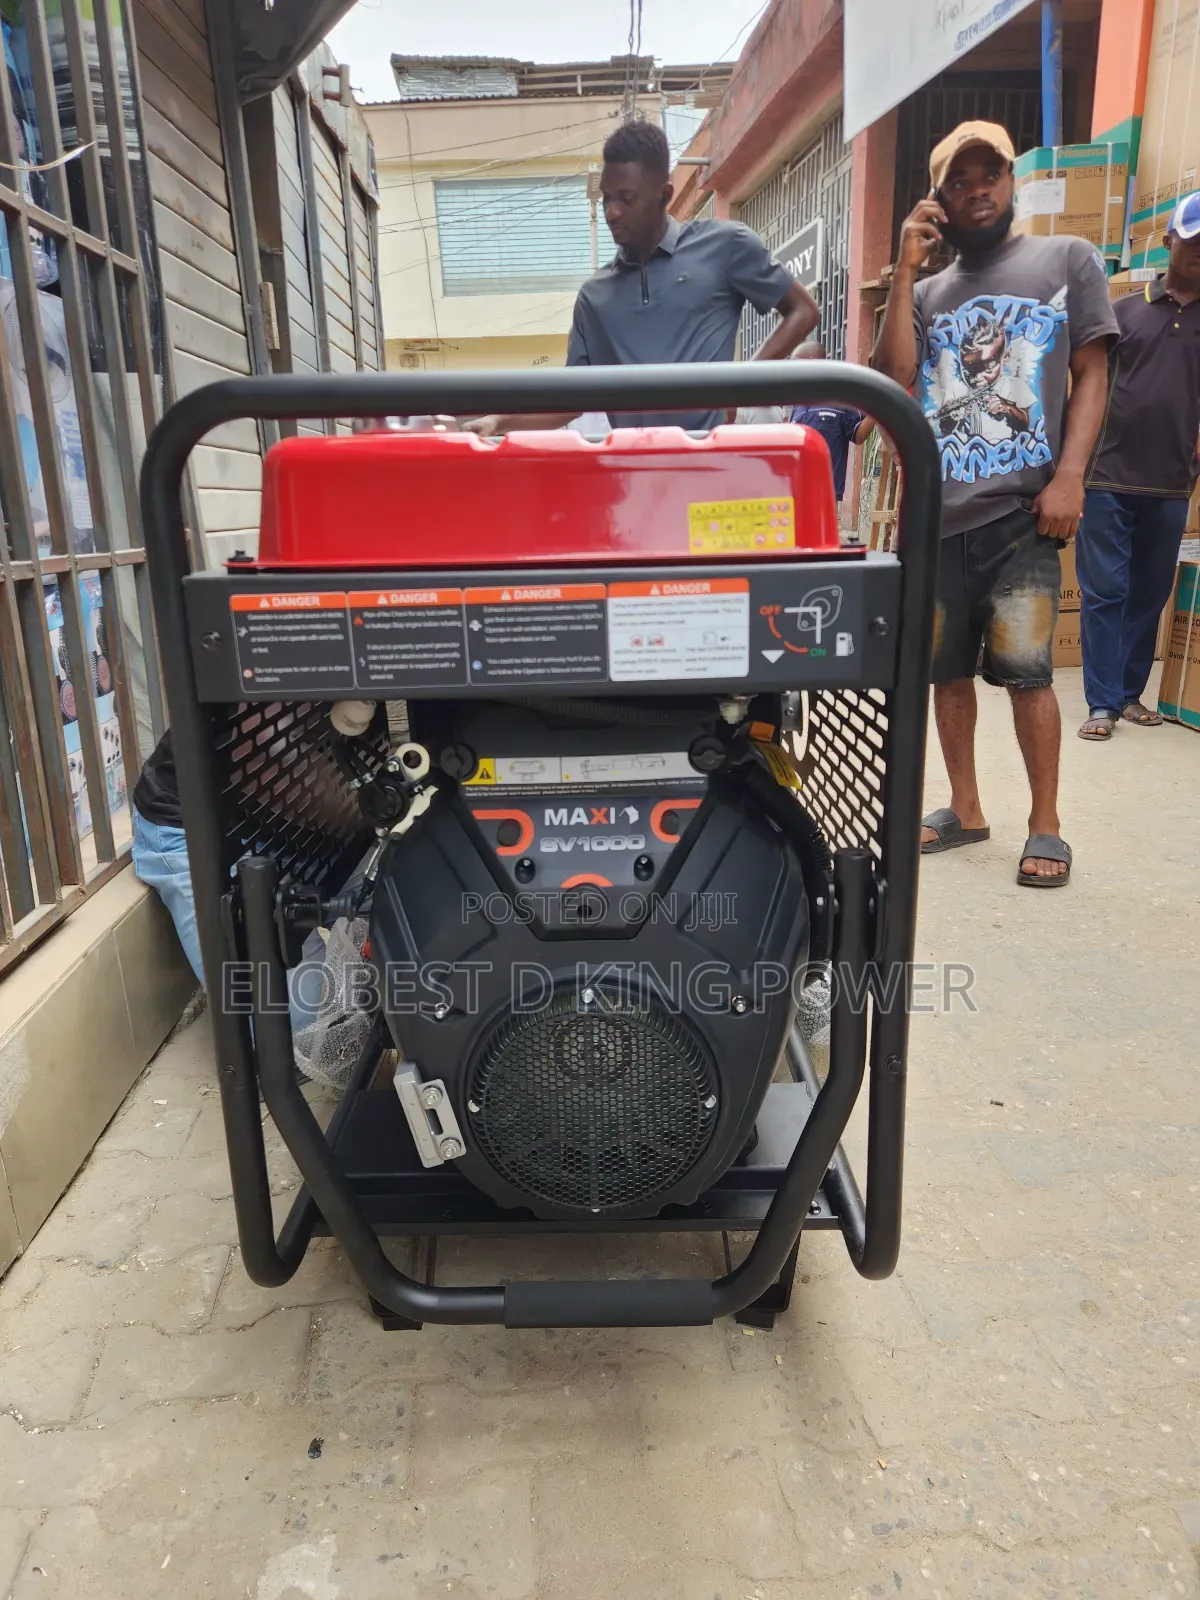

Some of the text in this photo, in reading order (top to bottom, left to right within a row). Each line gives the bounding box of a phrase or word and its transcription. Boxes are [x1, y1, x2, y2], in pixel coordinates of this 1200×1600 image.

[513, 588, 562, 600] DANGER
[662, 582, 711, 594] DANGER
[271, 596, 320, 607] DANGER
[390, 592, 438, 604] DANGER
[759, 604, 783, 616] OFF
[1174, 615, 1188, 625] AIR
[809, 647, 826, 658] ON
[544, 806, 615, 826] MAXI
[539, 834, 646, 853] SV1000
